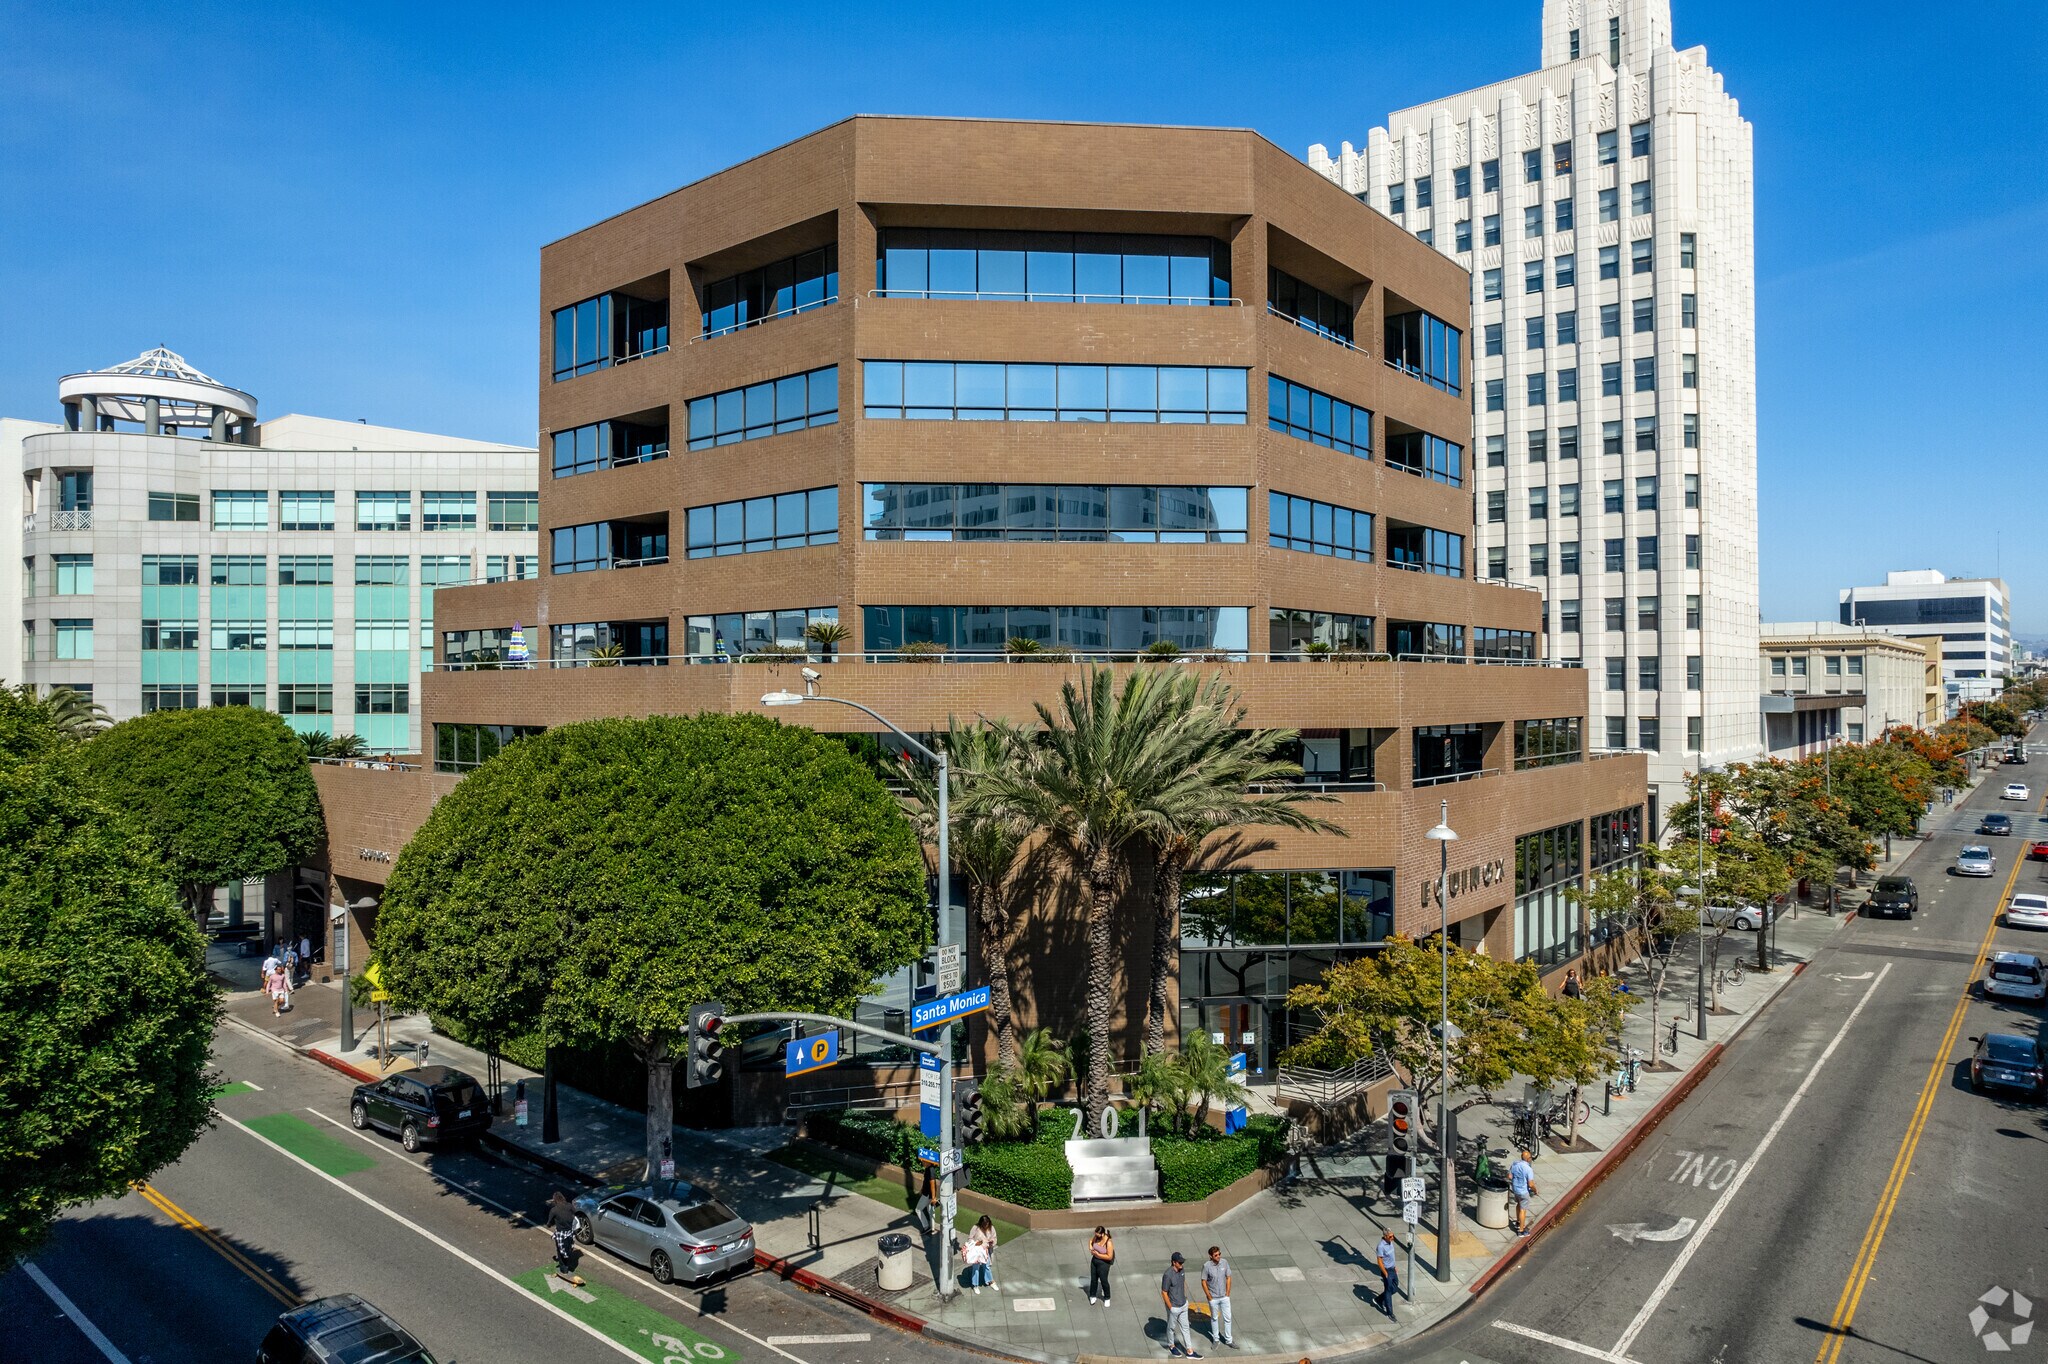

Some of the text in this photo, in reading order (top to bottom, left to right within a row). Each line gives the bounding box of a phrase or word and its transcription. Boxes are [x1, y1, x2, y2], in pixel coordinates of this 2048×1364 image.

[1421, 858, 1505, 904] EQUINOX
[941, 954, 957, 964] BLOCK
[941, 971, 958, 981] FINES TO
[943, 979, 956, 990] $500
[915, 992, 987, 1023] Santa Monica
[816, 1043, 825, 1058] P
[1069, 1105, 1146, 1140] 201
[1403, 1190, 1413, 1200] OK
